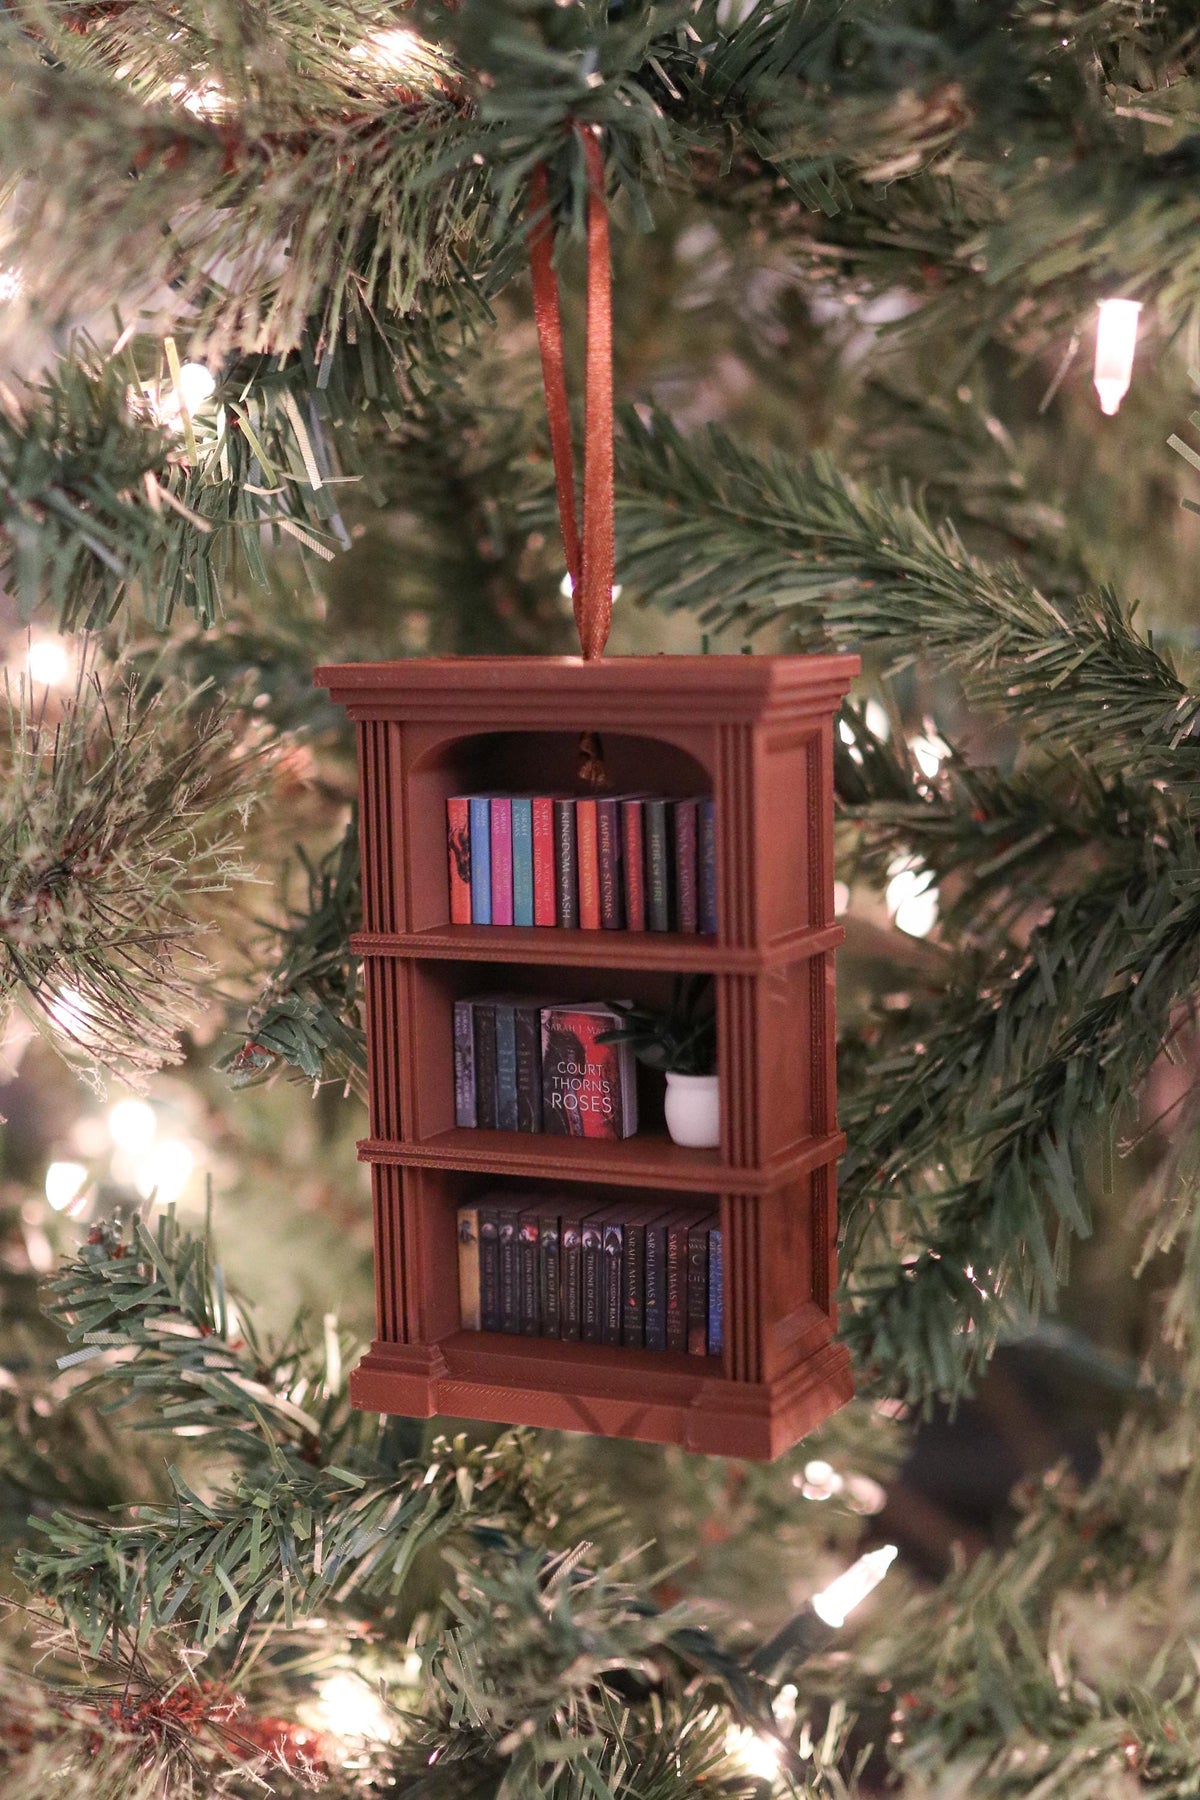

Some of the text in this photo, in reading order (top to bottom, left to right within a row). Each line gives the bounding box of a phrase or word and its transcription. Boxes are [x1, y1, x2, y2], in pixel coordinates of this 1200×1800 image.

[562, 812, 571, 872] KINGDOM
[583, 821, 591, 858] TOWER
[600, 815, 610, 854] EMPIRE
[652, 834, 660, 861] HEIR
[584, 873, 592, 907] DAWN
[603, 873, 613, 919] STORMS
[654, 880, 662, 903] FIRE
[562, 893, 571, 918] ASH
[557, 1061, 603, 1076] COURT
[552, 1076, 611, 1094] THORNS
[551, 1092, 612, 1114] ROSES
[628, 1230, 636, 1260] SARAH
[647, 1232, 656, 1262] SARAH
[669, 1233, 677, 1264] SARAH
[648, 1272, 656, 1298] MAAS
[669, 1273, 677, 1300] MAAS
[587, 1300, 595, 1323] GLASS
